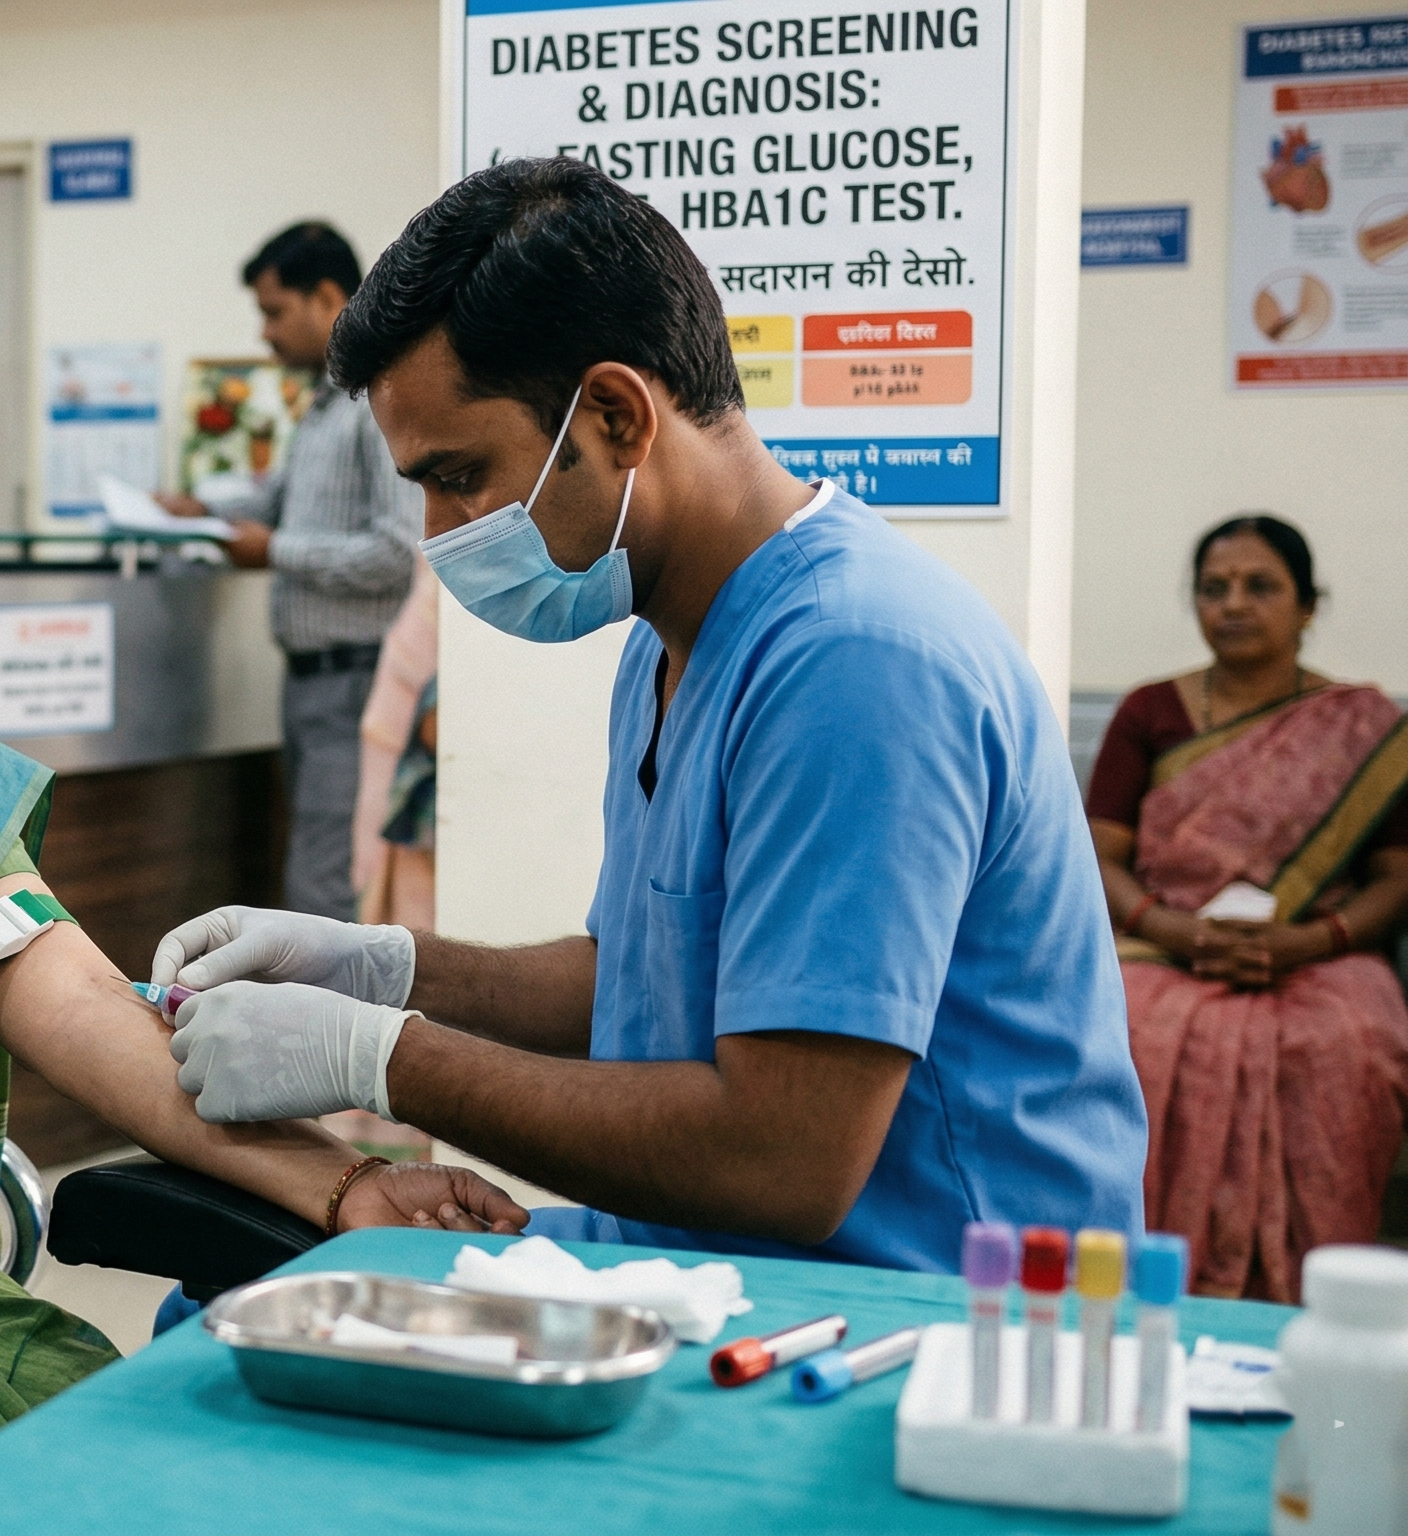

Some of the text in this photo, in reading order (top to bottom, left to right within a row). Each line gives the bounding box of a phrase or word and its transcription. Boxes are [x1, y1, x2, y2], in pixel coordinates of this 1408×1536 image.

[492, 7, 978, 75] DIABETES SCREENING
[578, 69, 880, 123] & DIAGNOSIS:
[753, 125, 972, 174] GLUCOSE,
[682, 180, 962, 230] HBA1C TEST.
[719, 247, 974, 293] सदारान की देसो.
